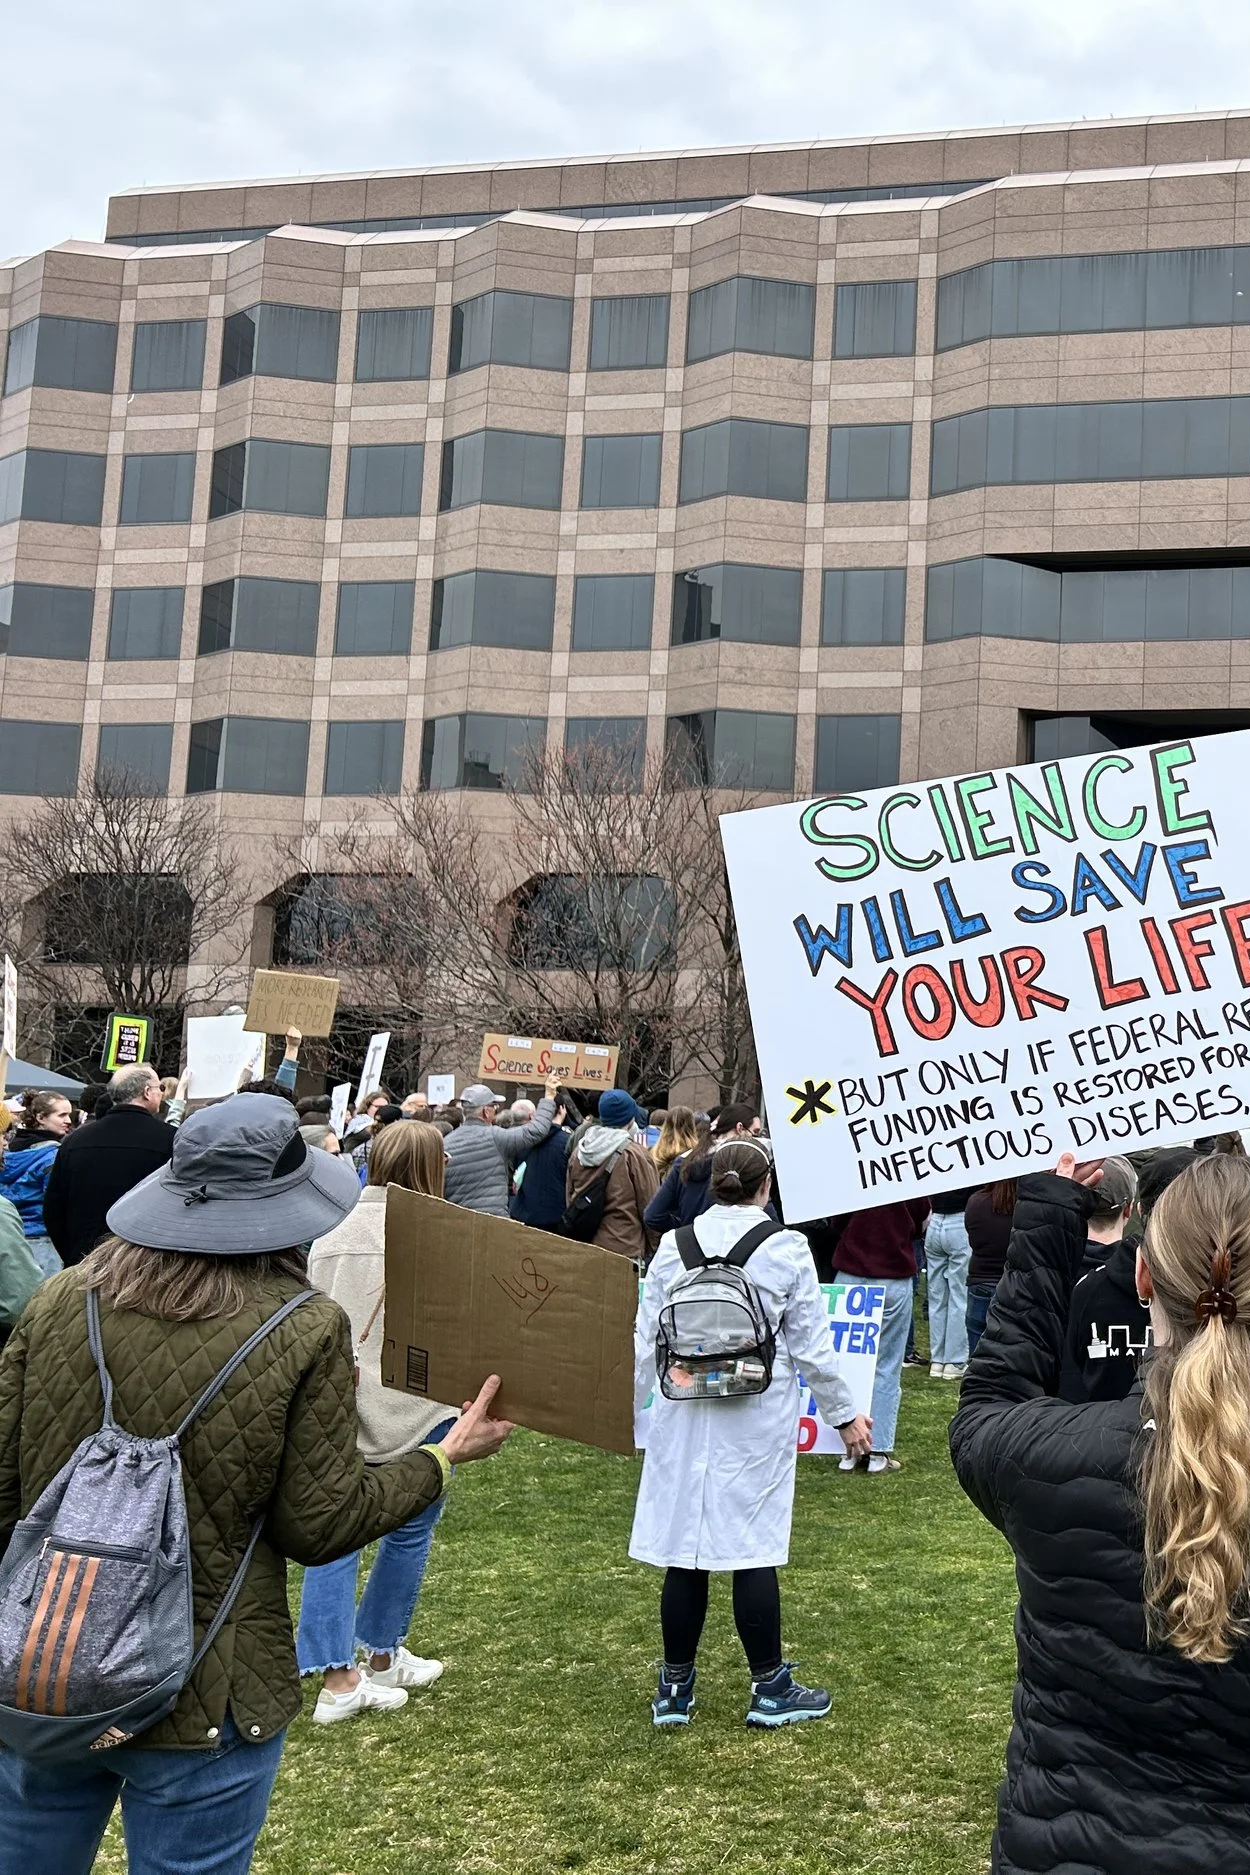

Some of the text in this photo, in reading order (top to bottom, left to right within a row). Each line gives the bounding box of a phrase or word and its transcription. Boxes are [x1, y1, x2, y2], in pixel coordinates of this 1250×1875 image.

[800, 740, 1218, 882] SCIENCE
[793, 839, 1225, 976] WILL SAVE
[259, 978, 336, 1001] MORE RESEARCH
[276, 1000, 332, 1030] NEEDED
[835, 946, 1069, 1057] YOUR
[483, 1044, 533, 1073] Science
[838, 1068, 908, 1116] BUT
[918, 1049, 1009, 1095] ONLY
[1027, 1040, 1055, 1075] IF
[1069, 1009, 1219, 1065] FEDERAL
[848, 1096, 995, 1153] FUNDING
[1010, 1086, 1043, 1116] IS
[1053, 1056, 1195, 1107] RESTORED
[858, 1123, 1053, 1188] INFECTIOUS
[1068, 1085, 1250, 1147] DISEASES,
[492, 1257, 549, 1310] 148
[846, 1285, 885, 1317] OF
[758, 1697, 778, 1709] HOKA
[90, 1732, 134, 1750] adidas
